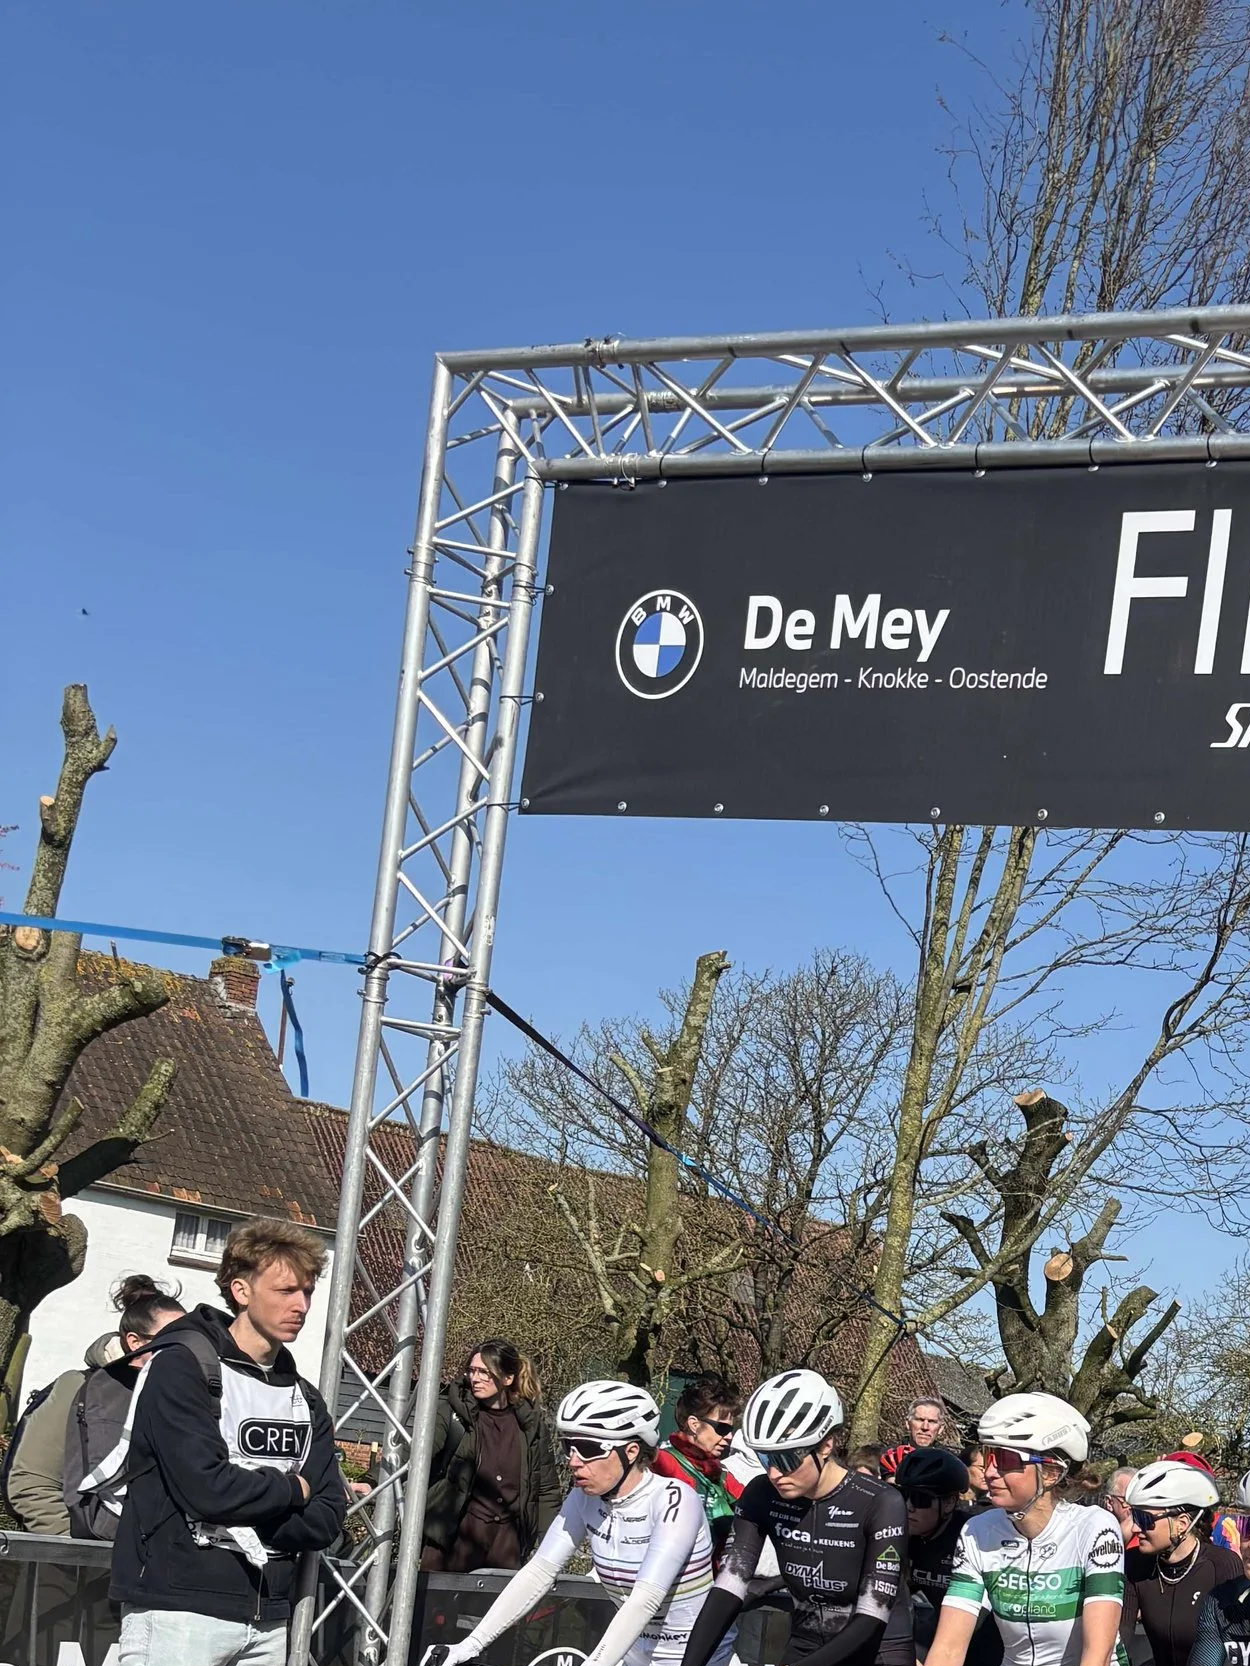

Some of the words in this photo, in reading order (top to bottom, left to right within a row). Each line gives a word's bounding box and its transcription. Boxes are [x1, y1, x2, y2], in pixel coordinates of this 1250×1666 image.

[631, 595, 695, 626] BMW
[743, 594, 813, 650] De
[830, 593, 951, 662] Mey
[738, 666, 839, 694] Maldegem
[857, 667, 929, 689] Knokke
[949, 666, 1049, 690] Oostende
[774, 1522, 811, 1544] foca
[874, 1525, 905, 1541] etixx
[997, 1573, 1062, 1591] SERSO
